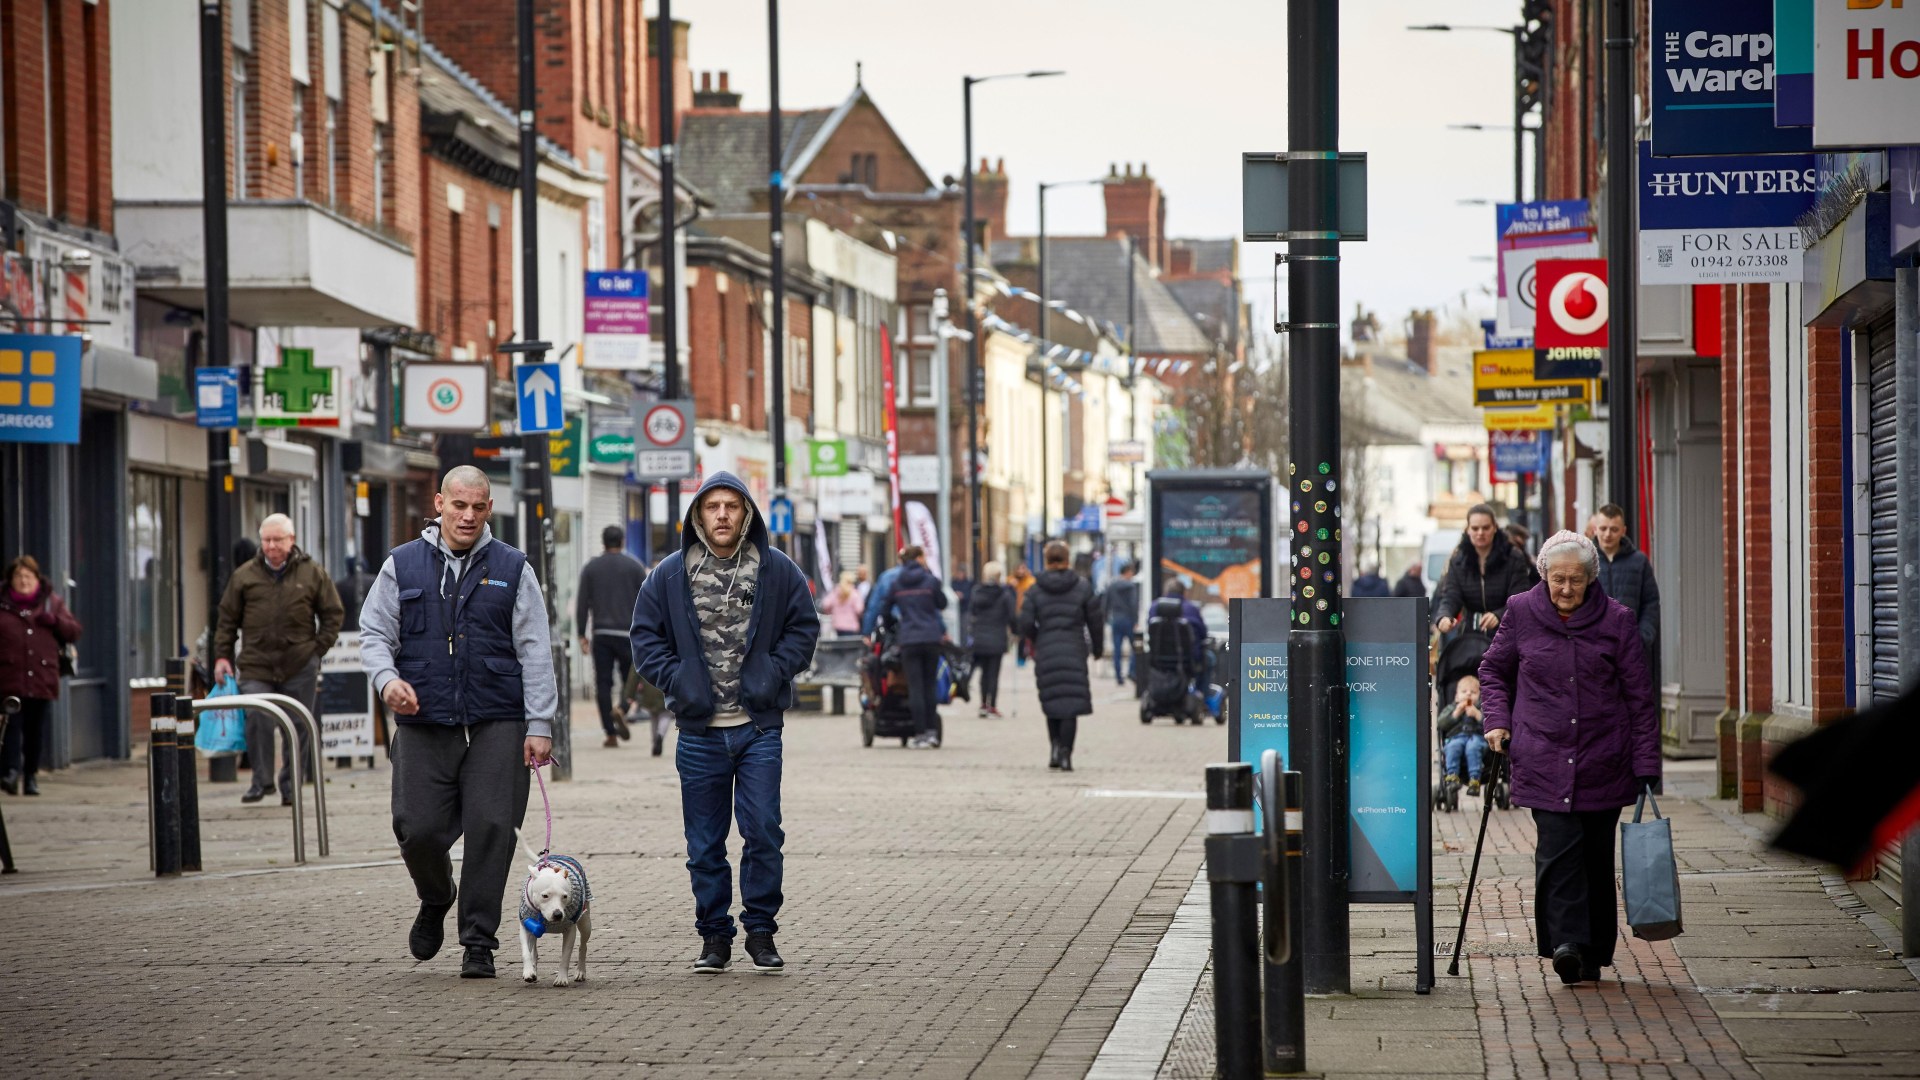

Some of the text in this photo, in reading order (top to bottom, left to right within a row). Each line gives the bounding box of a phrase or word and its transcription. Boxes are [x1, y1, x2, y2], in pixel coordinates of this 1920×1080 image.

[1665, 32, 1680, 62] THE
[1684, 31, 1773, 61] Carp
[1847, 28, 1920, 79] Ho
[1648, 169, 1815, 197] HUNTERS
[1523, 205, 1560, 219] to let
[1682, 232, 1799, 251] FOR SALE
[1691, 255, 1788, 267] 01942 673308
[598, 276, 633, 291] to let
[1494, 386, 1569, 400] We buy gold
[1375, 656, 1384, 666] 11
[1386, 656, 1410, 666] PRO
[1272, 714, 1283, 722] get
[1363, 806, 1407, 814] iPhone 11 Pro
